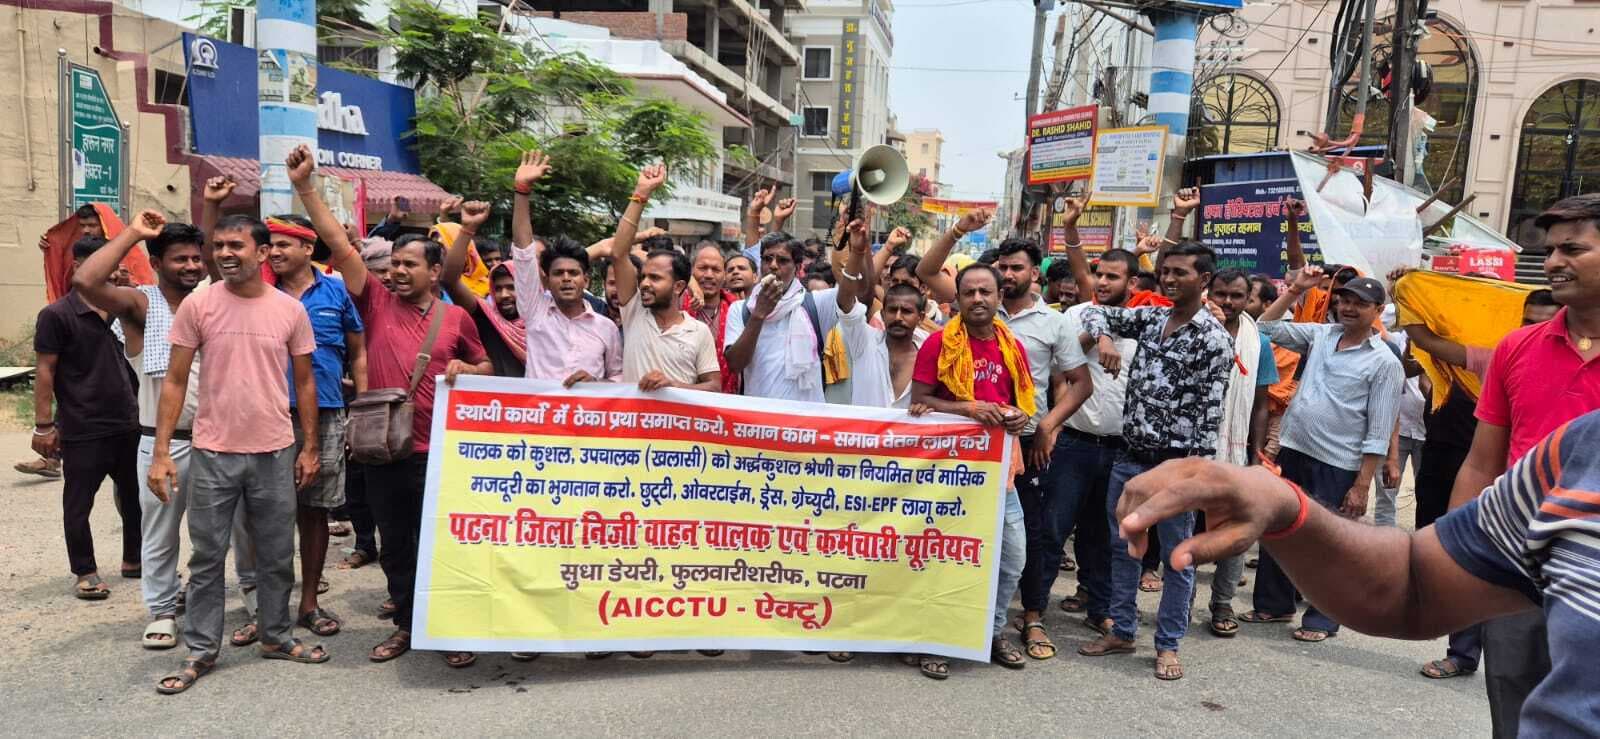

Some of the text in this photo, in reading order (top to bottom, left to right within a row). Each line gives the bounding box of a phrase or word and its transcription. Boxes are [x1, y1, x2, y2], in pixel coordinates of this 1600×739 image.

[1042, 124, 1066, 136] RASHID
[1066, 120, 1092, 132] SHAHID
[338, 151, 382, 170] CORNER
[1469, 256, 1504, 267] LASSI
[455, 400, 502, 422] स्थायी
[553, 404, 567, 425] में
[573, 407, 606, 427] ठेका
[609, 412, 637, 430] प्रथा
[640, 414, 692, 432] समाप्त
[695, 414, 728, 437] करो,
[733, 422, 778, 442] समान
[781, 426, 816, 445] काम
[834, 432, 879, 449] समान
[922, 434, 958, 457] लागू
[960, 430, 991, 451] करो
[458, 442, 502, 461] चालक
[507, 438, 526, 461] को
[530, 445, 575, 470] कुशल,
[580, 448, 640, 467] उपचालक
[644, 444, 707, 474] (खलासी)
[712, 449, 729, 471] को
[804, 458, 834, 479] श्रेणी
[838, 464, 856, 479] का
[860, 459, 912, 484] नियमित
[916, 462, 935, 485] एवं
[938, 463, 986, 488] मासिक
[471, 472, 522, 502] मजदूरी
[526, 478, 545, 496] का
[549, 482, 600, 505] भुगतान
[603, 477, 635, 499] करो.
[844, 494, 898, 513] ESI-EPF
[902, 498, 934, 525] लागू
[936, 496, 966, 517] करो.
[449, 507, 985, 570] पटना जिला निजी वाहन चालक एवं कर्मचारी यूनियन
[560, 556, 868, 590] सुधा डेयरी, फुलवारीशरीफ, पटना
[598, 590, 728, 626] (AICCTU
[755, 591, 833, 630] ऐक्टू)
